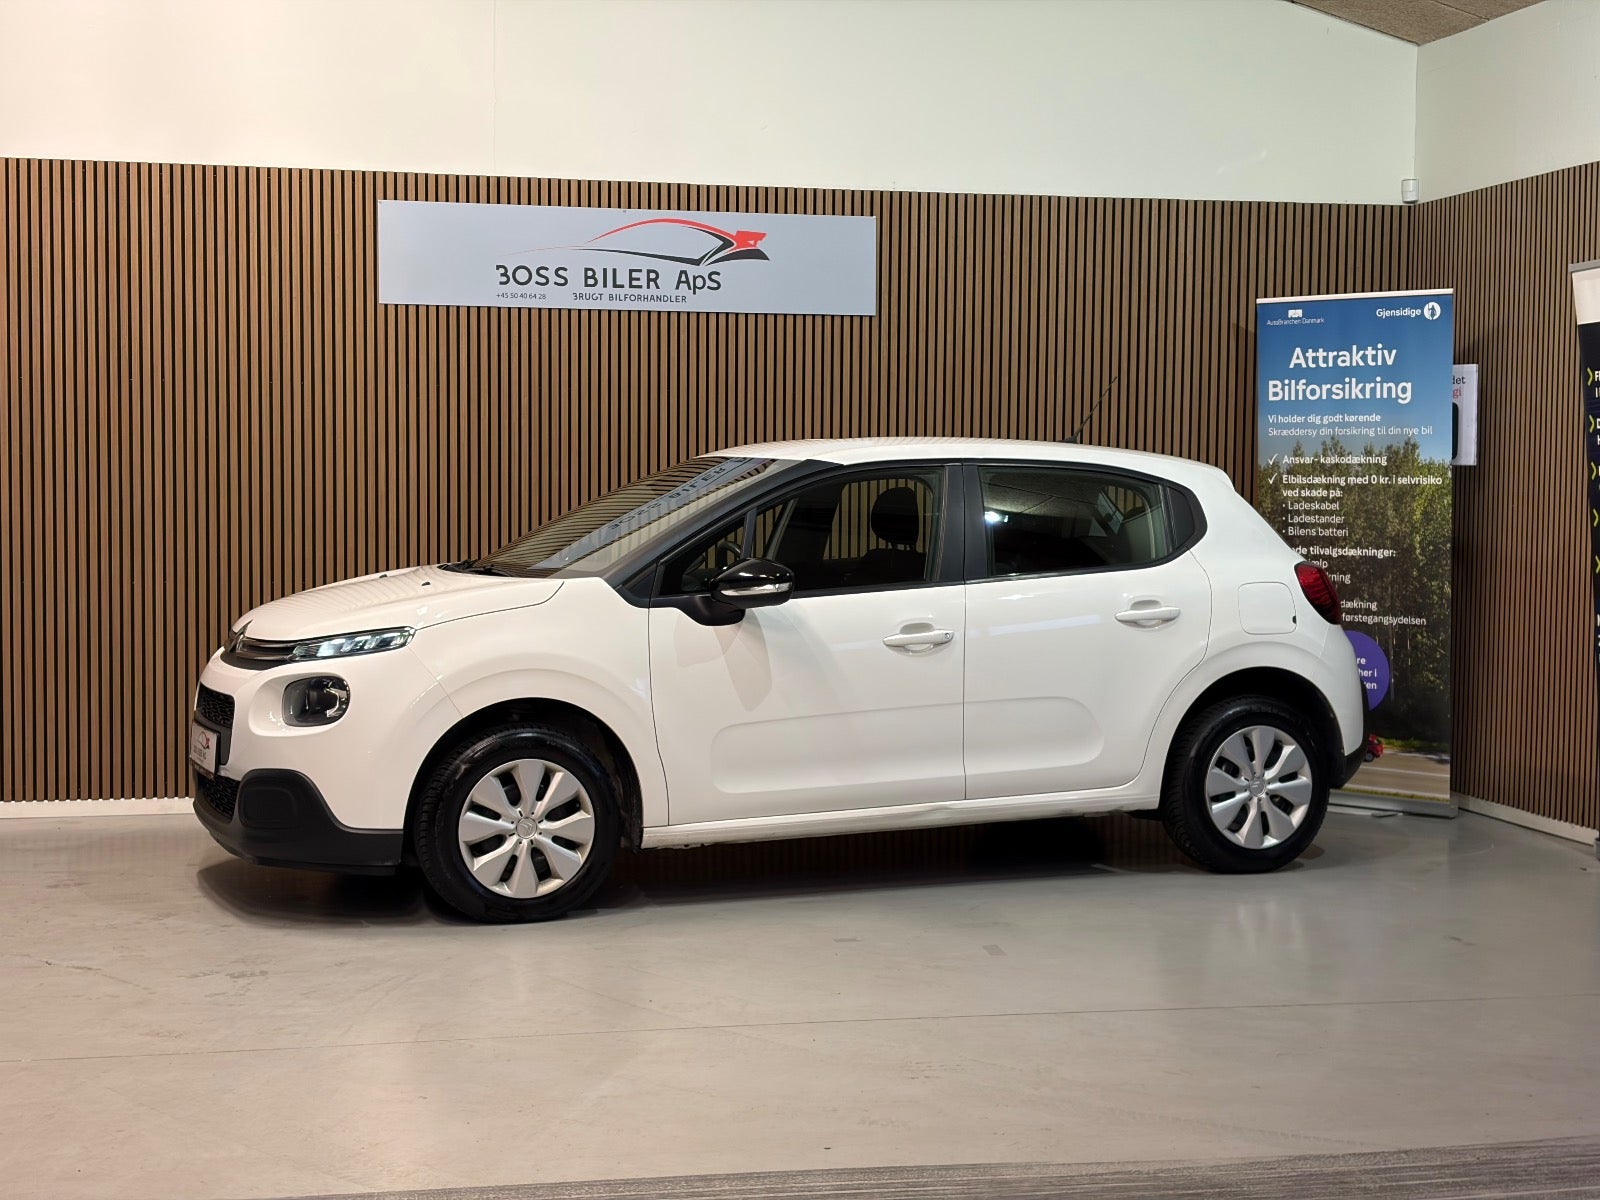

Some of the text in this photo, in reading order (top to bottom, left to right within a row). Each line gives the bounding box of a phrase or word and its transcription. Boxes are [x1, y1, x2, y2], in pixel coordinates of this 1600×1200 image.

[584, 267, 660, 290] BILER
[675, 270, 722, 294] ApS
[608, 294, 687, 303] BILFORHANDLER
[1376, 308, 1422, 320] Gjensidige
[1289, 344, 1396, 368] Attraktiv
[1268, 377, 1412, 404] Bilforsikring
[1268, 413, 1381, 424] Vi holder dig godt kørende
[1268, 426, 1433, 437] Skræddersy din forsikring til din nye bil
[1282, 454, 1387, 466] Ansvar- kaskodækning
[1282, 474, 1346, 486] Elbilsdækning
[1348, 475, 1368, 484] med
[1370, 475, 1377, 484] 0
[1379, 475, 1391, 484] kr.
[1398, 475, 1442, 485] selvrisiko
[1282, 487, 1343, 499] ved skade på:
[1288, 501, 1340, 510] Ladeskabel
[1288, 514, 1344, 524] Ladestander
[1288, 526, 1349, 537] Bilens batteri
[1310, 546, 1396, 559] tilvalgsdækninger:
[1342, 613, 1427, 628] førstegangsydelsen
